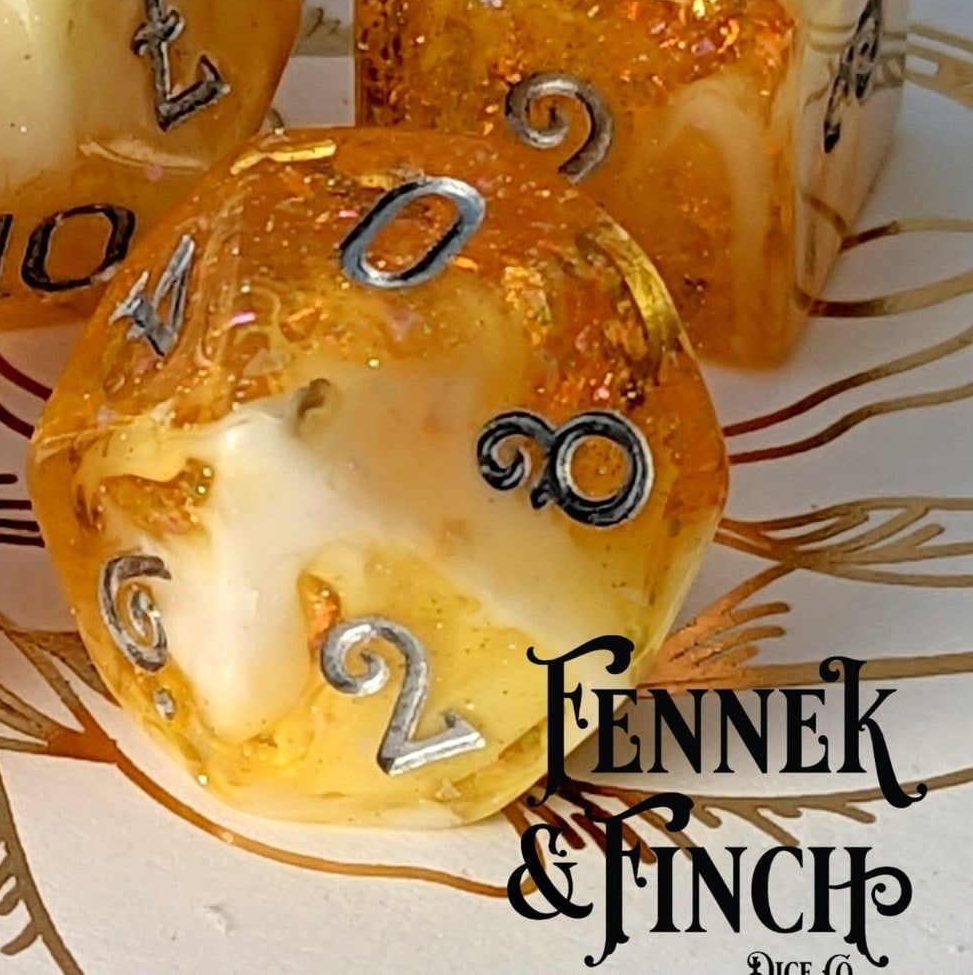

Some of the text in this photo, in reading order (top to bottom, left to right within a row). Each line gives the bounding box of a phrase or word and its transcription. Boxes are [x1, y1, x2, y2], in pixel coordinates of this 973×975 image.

[339, 176, 487, 288] 0
[477, 409, 656, 529] 8
[321, 615, 487, 777] 2
